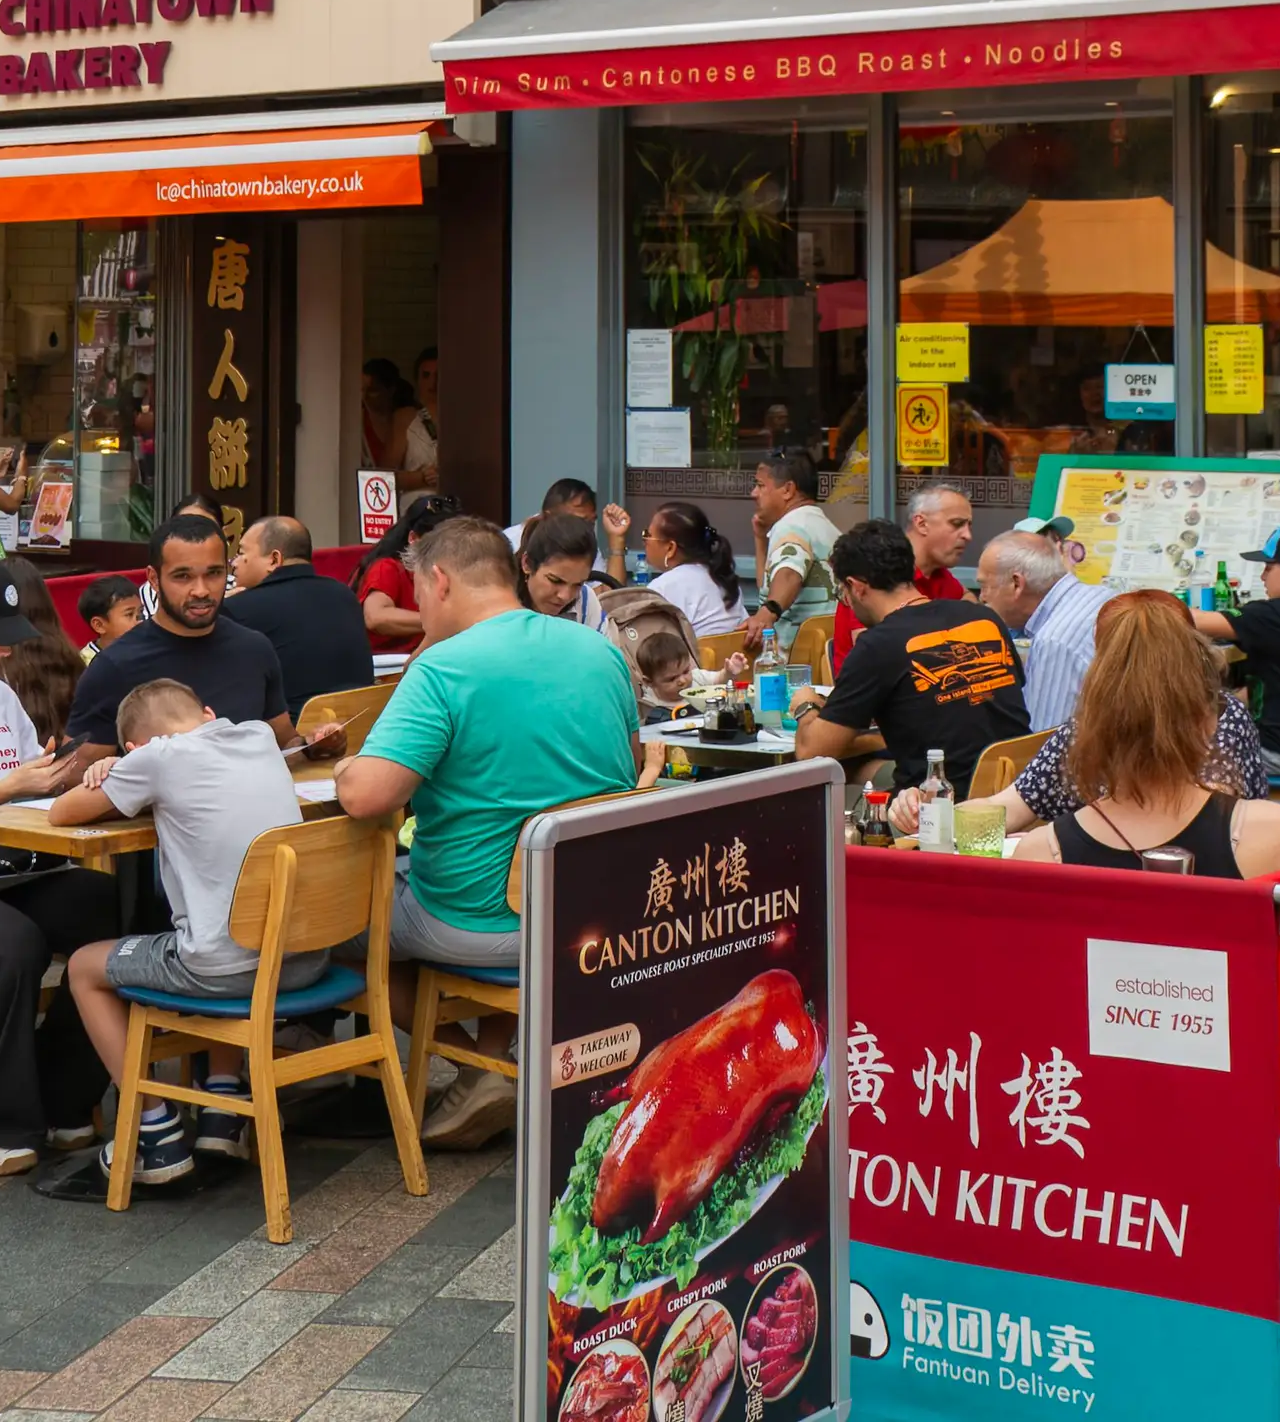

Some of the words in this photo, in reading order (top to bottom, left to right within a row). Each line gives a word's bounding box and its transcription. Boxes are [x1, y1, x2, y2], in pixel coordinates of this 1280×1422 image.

[454, 76, 500, 95] Dim
[518, 71, 573, 93] Sum
[602, 63, 757, 89] Cantonese
[776, 55, 838, 79] BBQ
[858, 47, 948, 74] Roast
[984, 39, 1125, 66] Noodles
[155, 170, 364, 203] lc@chinatownbakery.co.uk
[900, 335, 912, 343] Air
[913, 334, 966, 344] conditioning
[931, 347, 944, 355] the
[909, 360, 935, 368] indoor
[1124, 374, 1157, 386] OPEN
[375, 517, 391, 525] ENTRY
[643, 837, 751, 919] 廣州樓
[579, 914, 693, 975] CANTON
[701, 885, 801, 942] KITCHEN
[610, 963, 662, 989] CANTONESE
[663, 956, 691, 974] ROAST
[691, 943, 734, 966] SPECIALIST
[734, 936, 757, 952] SINCE
[758, 930, 776, 945] 1955
[1115, 976, 1215, 1003] established
[1104, 1004, 1162, 1031] SINCE
[1169, 1011, 1215, 1036] 1955
[580, 1029, 632, 1056] TAKEAWAY
[580, 1048, 629, 1074] WELCOME
[848, 1148, 942, 1217] TON
[955, 1169, 1189, 1258] KITCHEN
[753, 1254, 782, 1275] ROAST
[782, 1242, 807, 1262] PORK
[667, 1287, 699, 1313] CRISPY
[700, 1277, 727, 1299] PORK
[573, 1330, 608, 1354] ROAST
[609, 1316, 638, 1340] DUCK
[901, 1291, 1096, 1381] 饭团外卖
[901, 1346, 991, 1388] Fantuan
[998, 1366, 1096, 1413] Delivery
